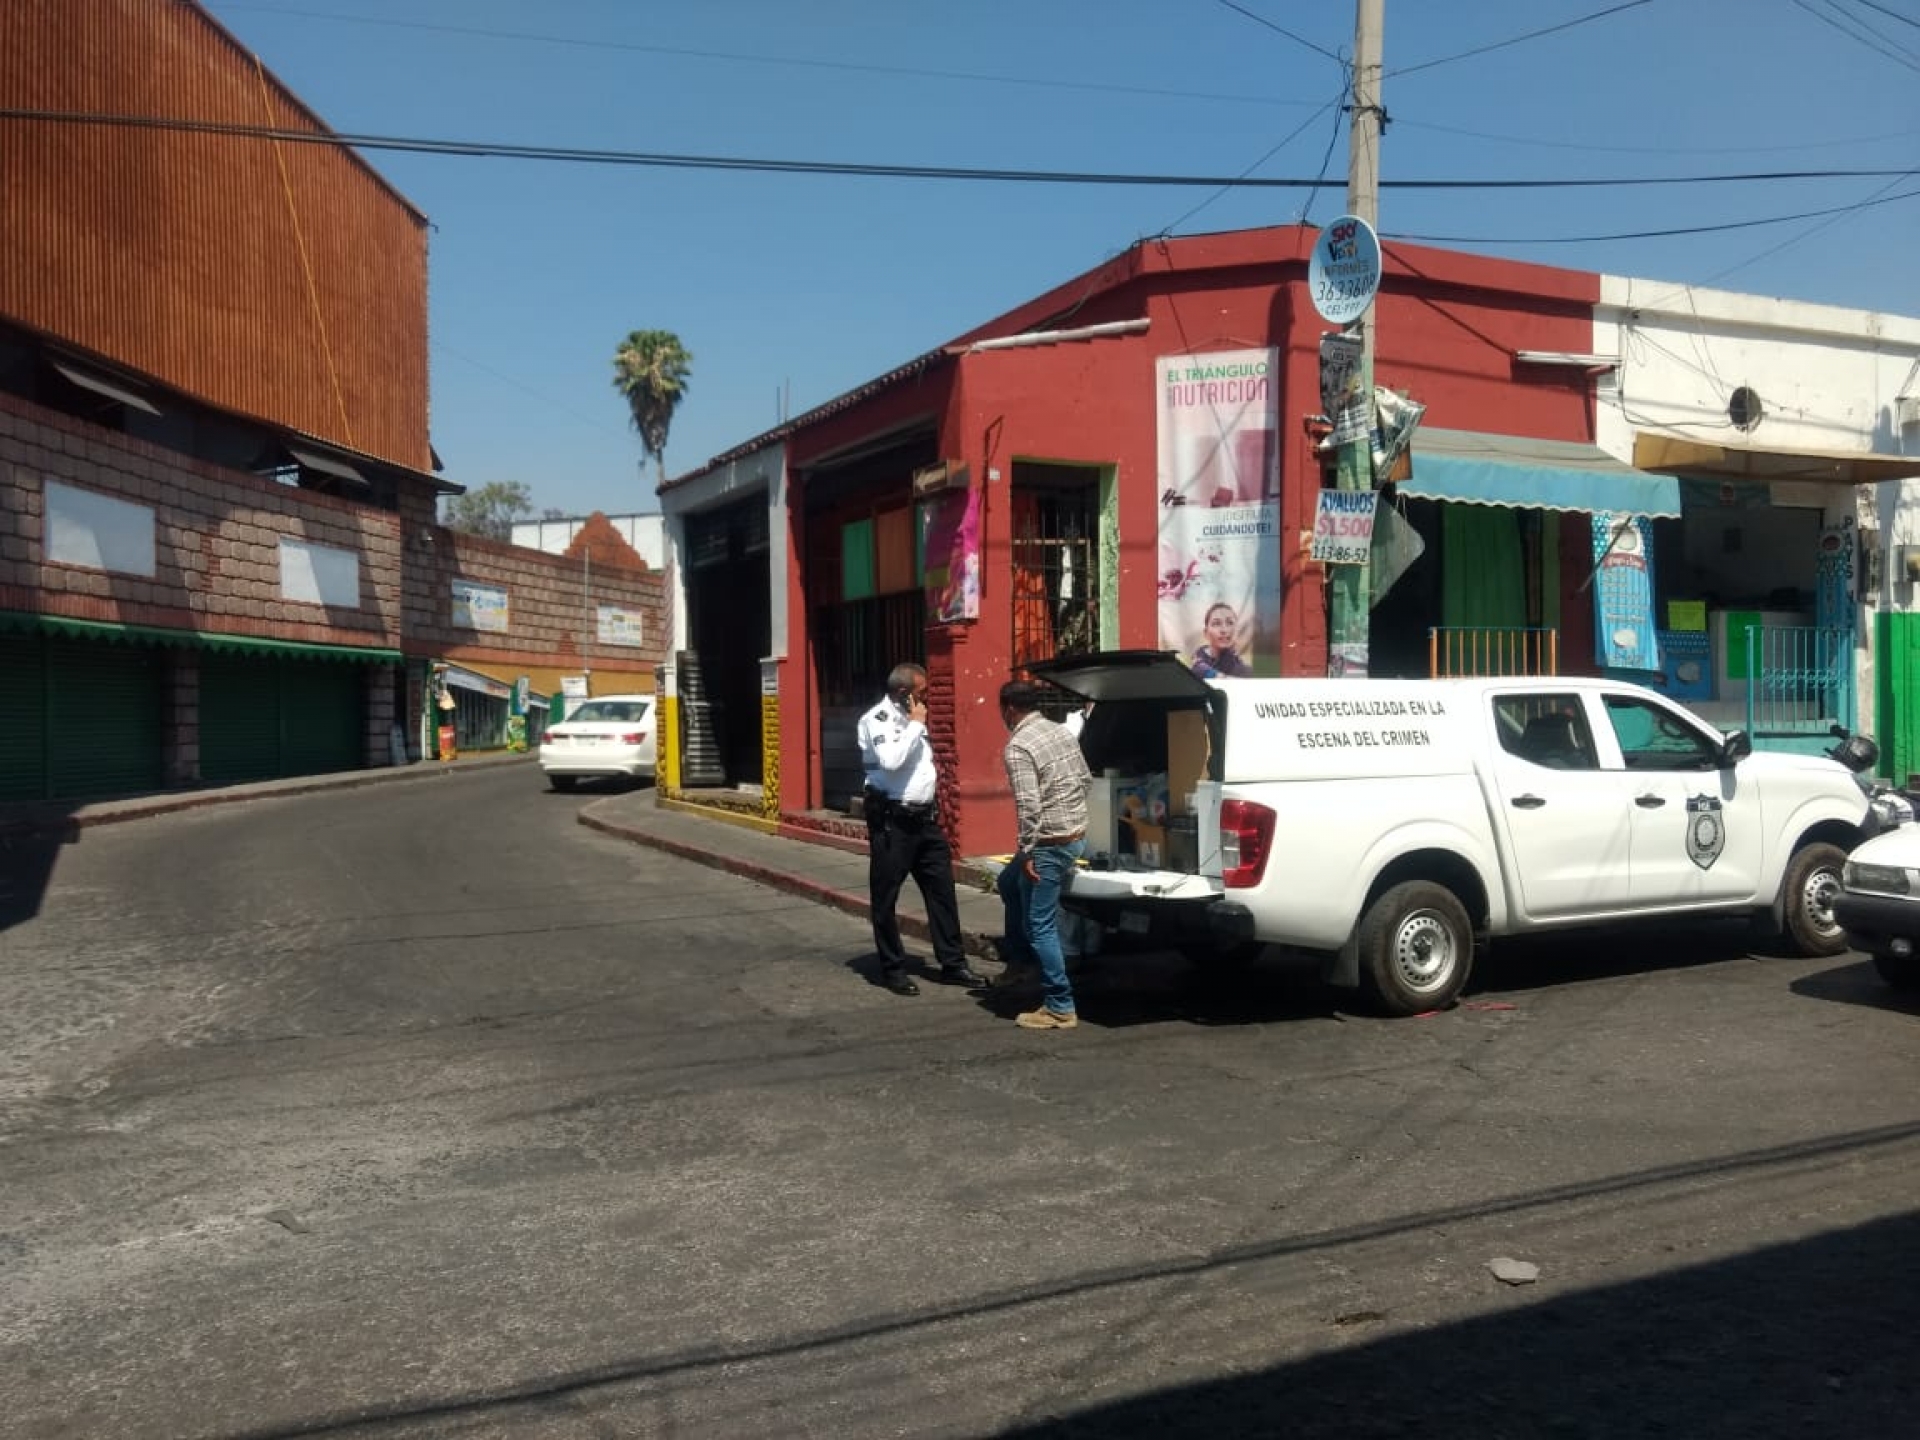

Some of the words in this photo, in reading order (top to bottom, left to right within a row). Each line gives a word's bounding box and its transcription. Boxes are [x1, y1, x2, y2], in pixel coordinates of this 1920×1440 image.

[1167, 369, 1180, 382] EL
[1254, 702, 1307, 719] UNIDAD
[1309, 701, 1408, 718] ESPECIALIZADA
[1409, 701, 1428, 716] EN
[1429, 700, 1446, 716] LA
[1298, 732, 1352, 749] ESCENA
[1353, 731, 1380, 747] DEL
[1381, 730, 1431, 746] CRIMEN
